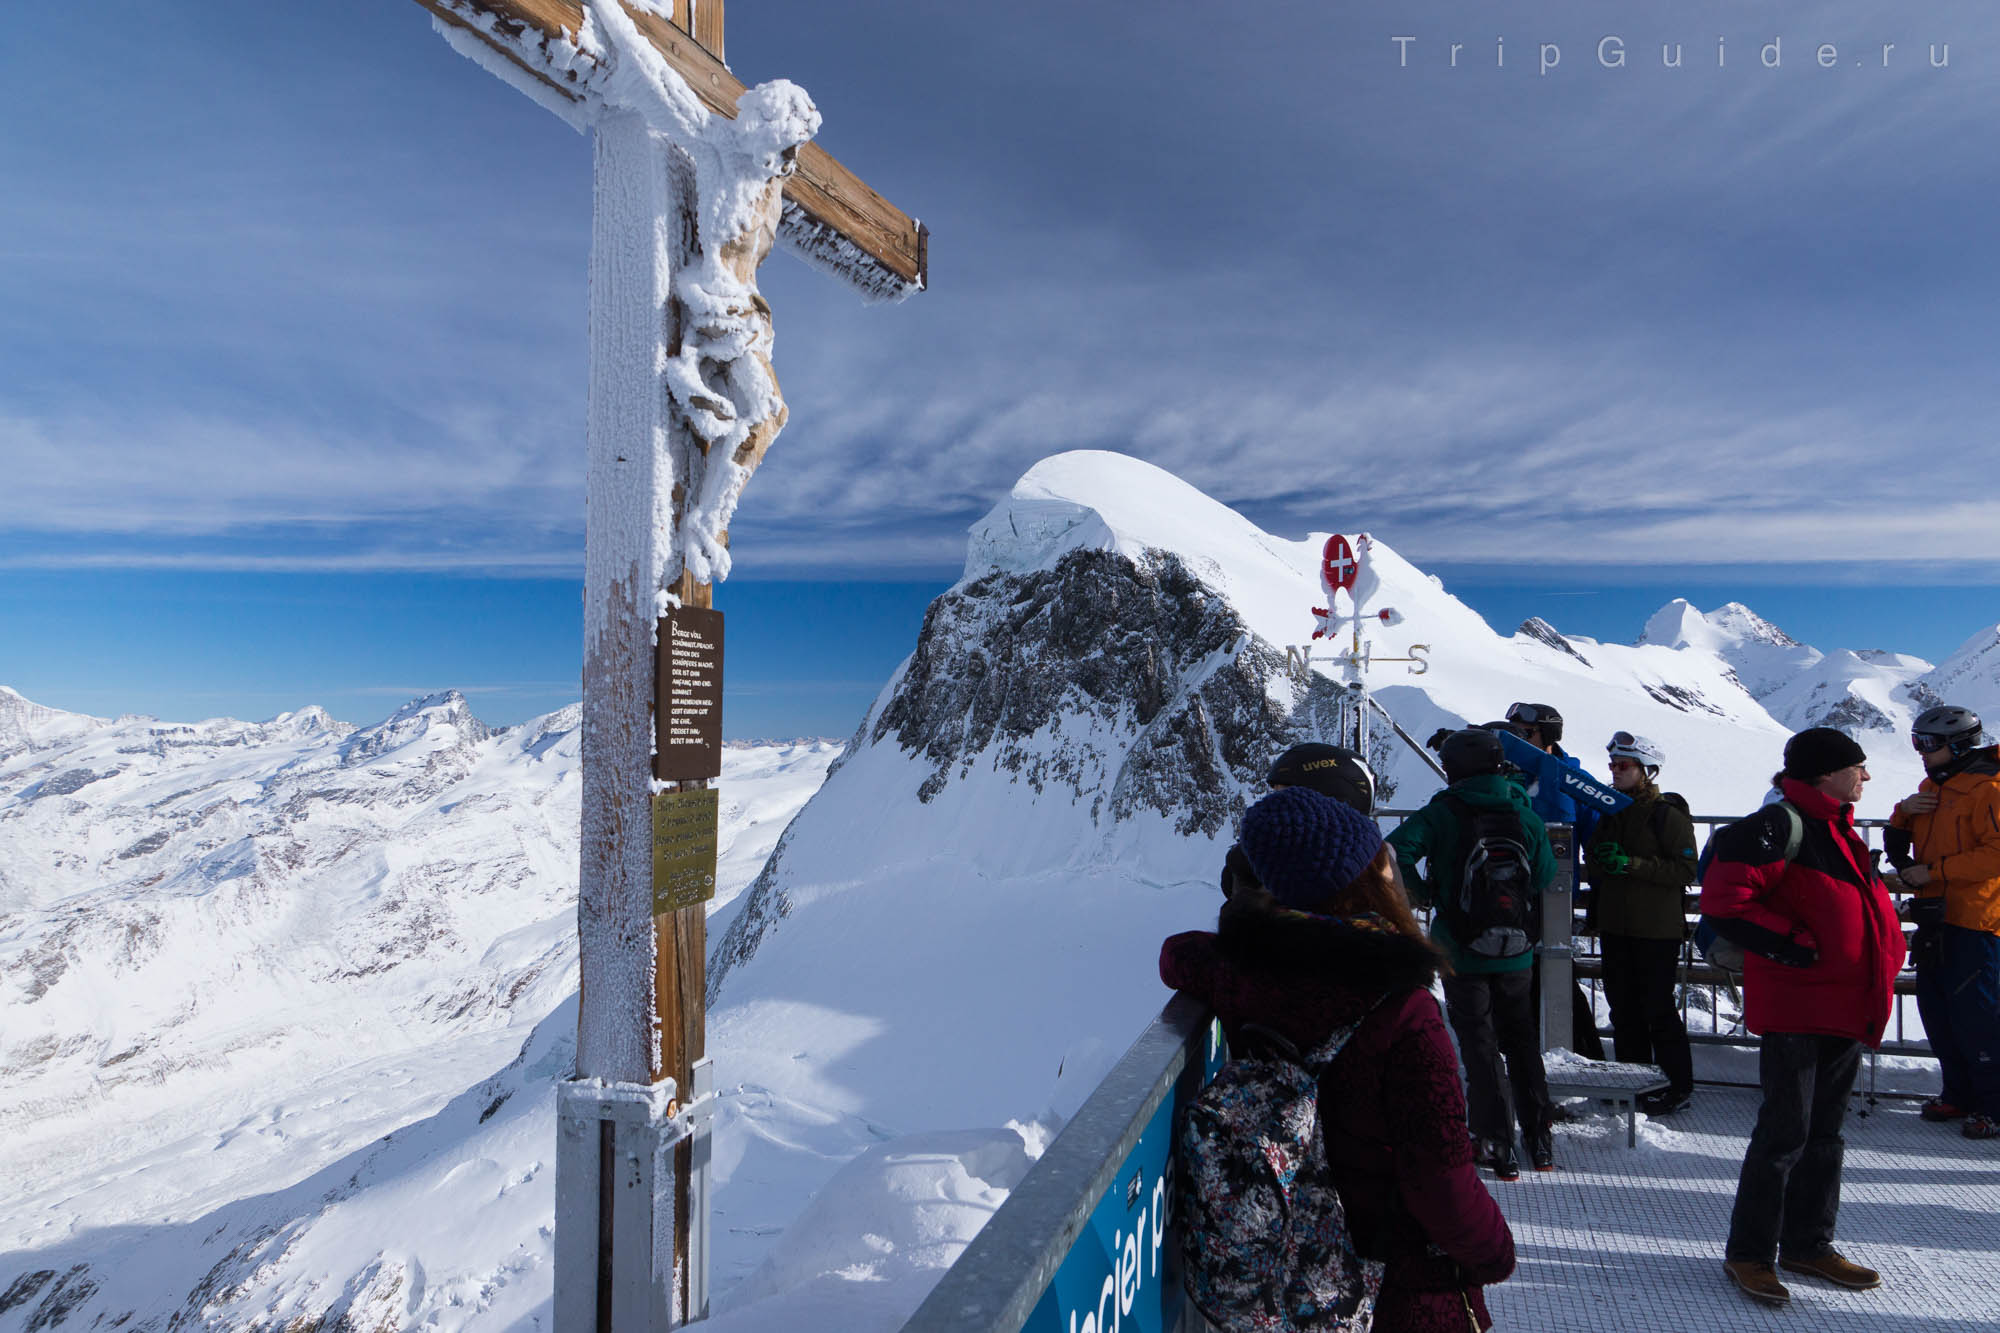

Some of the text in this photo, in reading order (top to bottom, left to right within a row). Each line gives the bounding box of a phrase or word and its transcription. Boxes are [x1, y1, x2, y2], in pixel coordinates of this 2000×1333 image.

[1408, 644, 1432, 675] S
[1303, 758, 1338, 772] uvex
[1565, 773, 1616, 806] VISIO
[1070, 1207, 1147, 1333] cier
